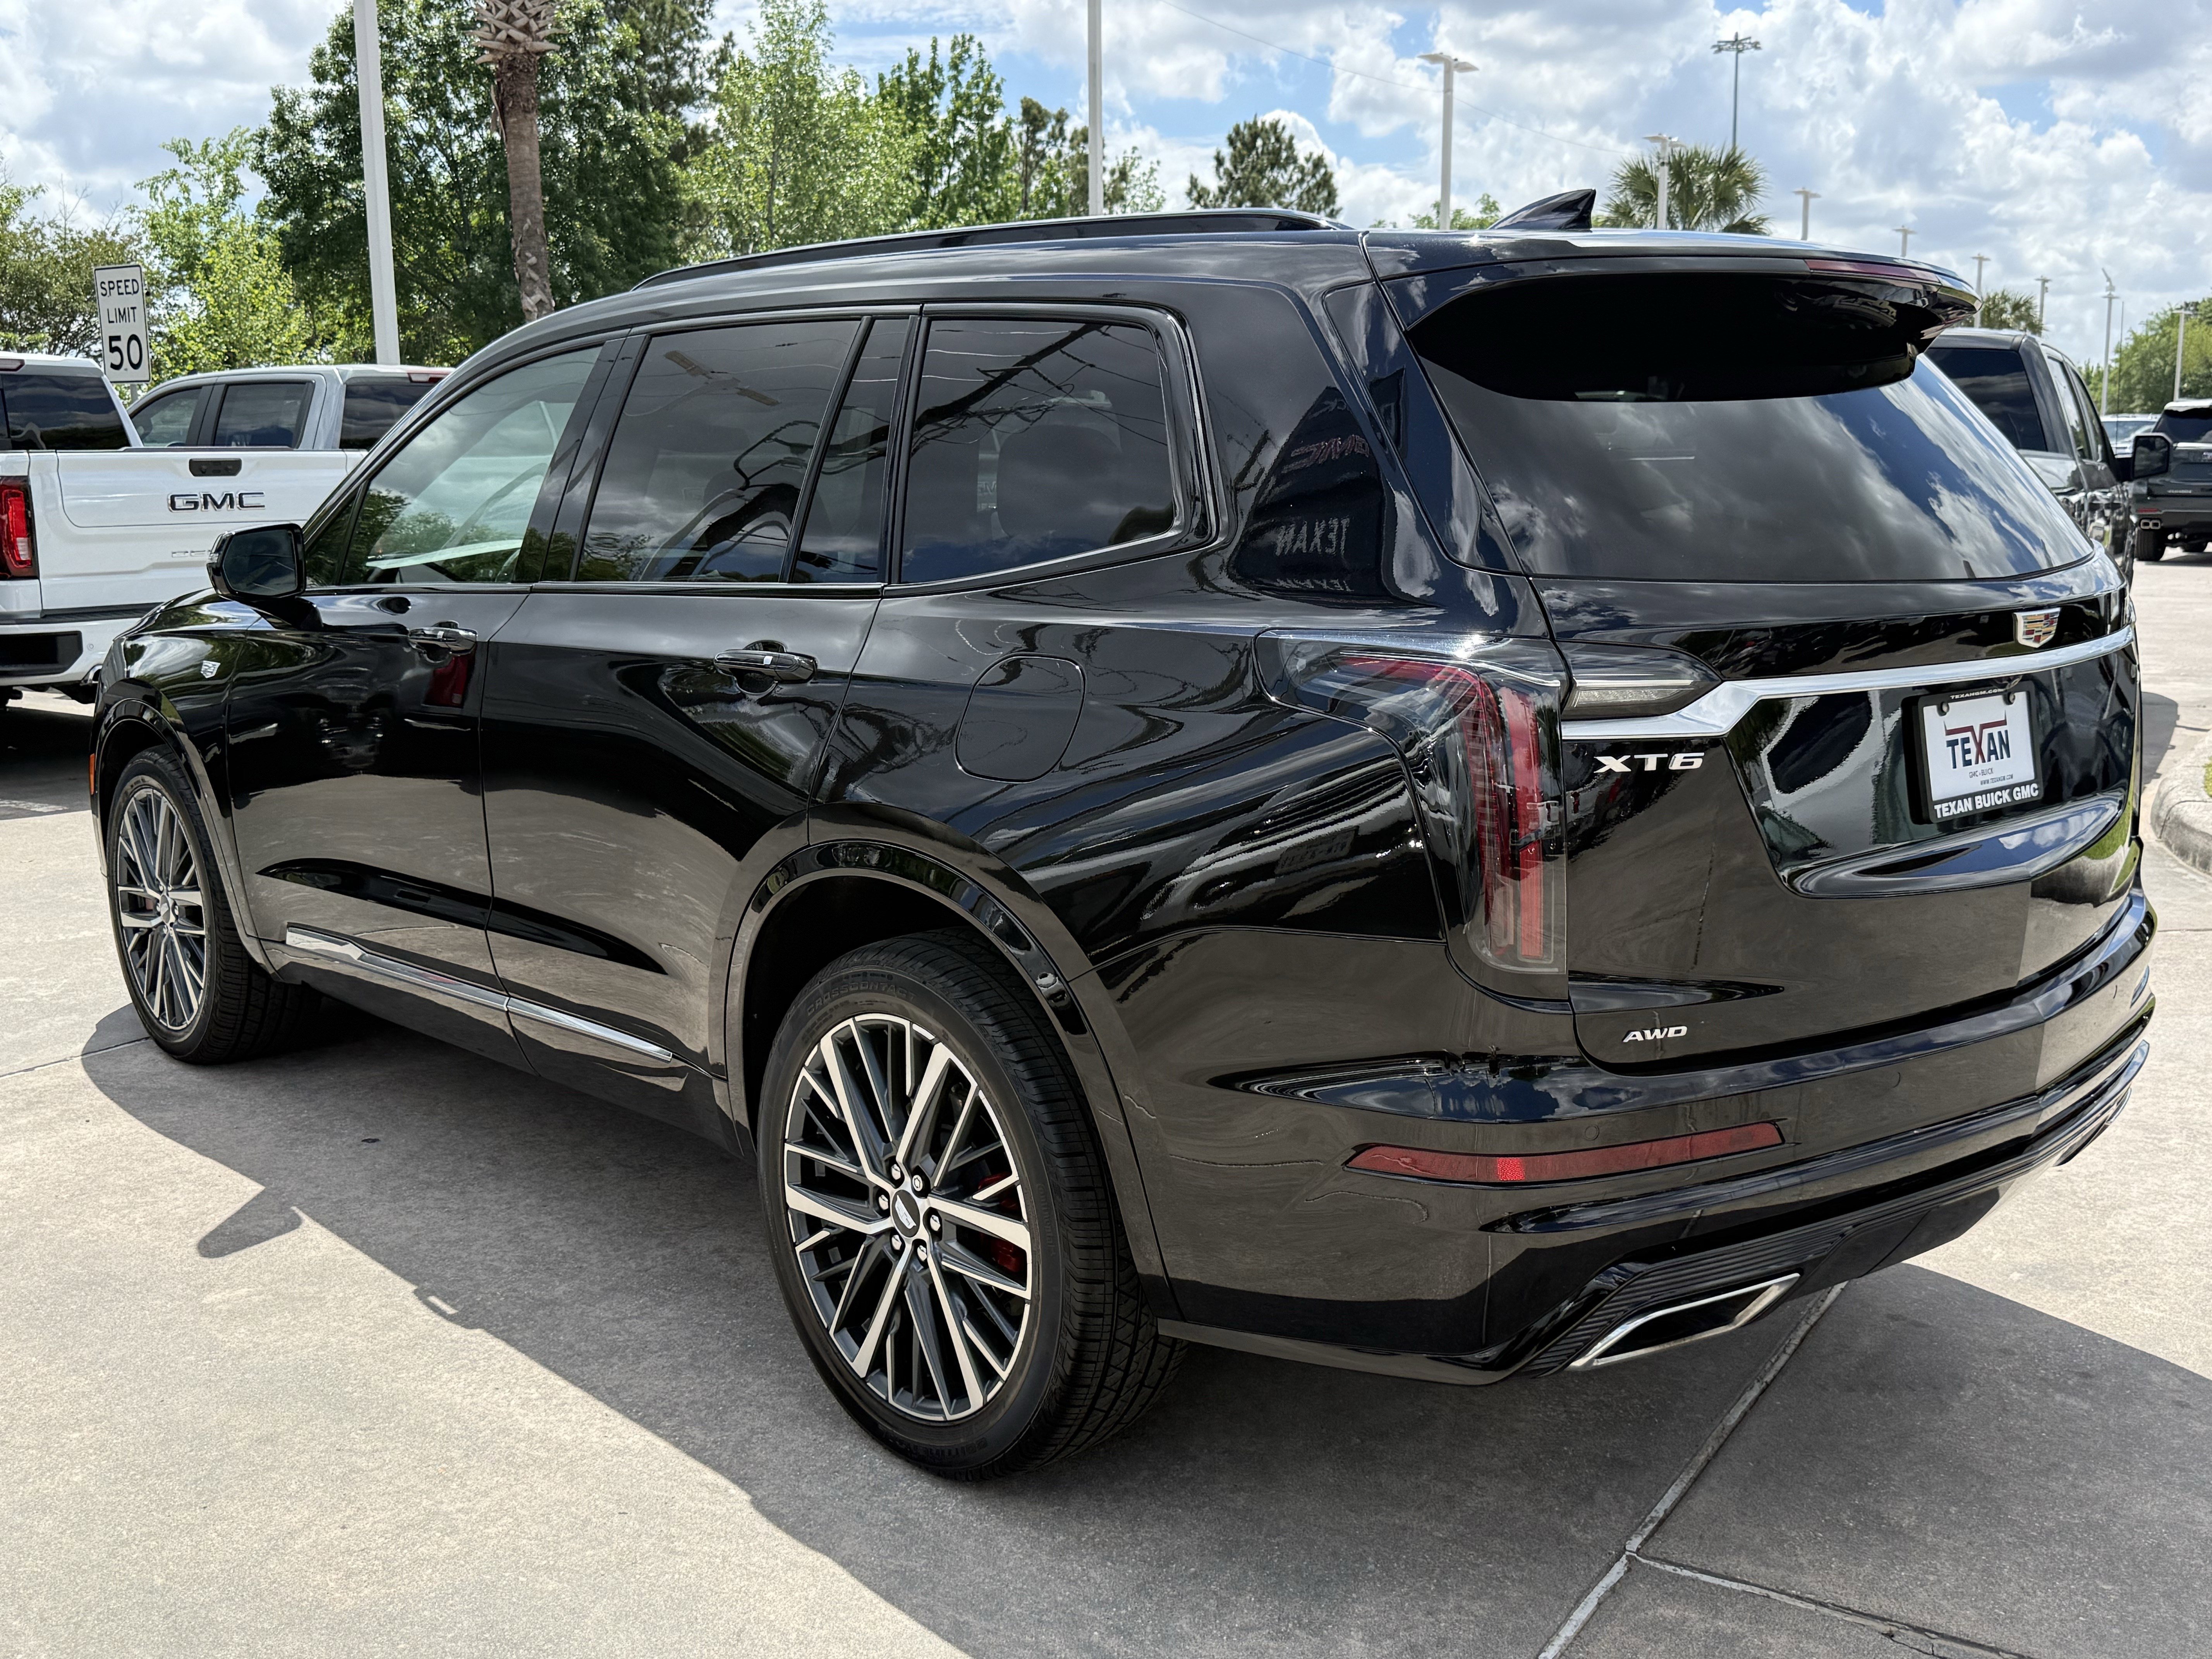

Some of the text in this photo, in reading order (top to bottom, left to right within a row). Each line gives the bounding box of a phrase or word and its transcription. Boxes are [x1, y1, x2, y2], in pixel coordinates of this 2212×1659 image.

[100, 278, 139, 297] SPEED
[107, 306, 137, 323] LIMIT
[108, 333, 143, 371] 50
[168, 491, 266, 512] GMC
[1944, 720, 2011, 769] TEXAN
[1593, 752, 1705, 773] XT6
[1934, 783, 2039, 819] TEXAN BUICK GMC
[1622, 1025, 1688, 1042] AWD
